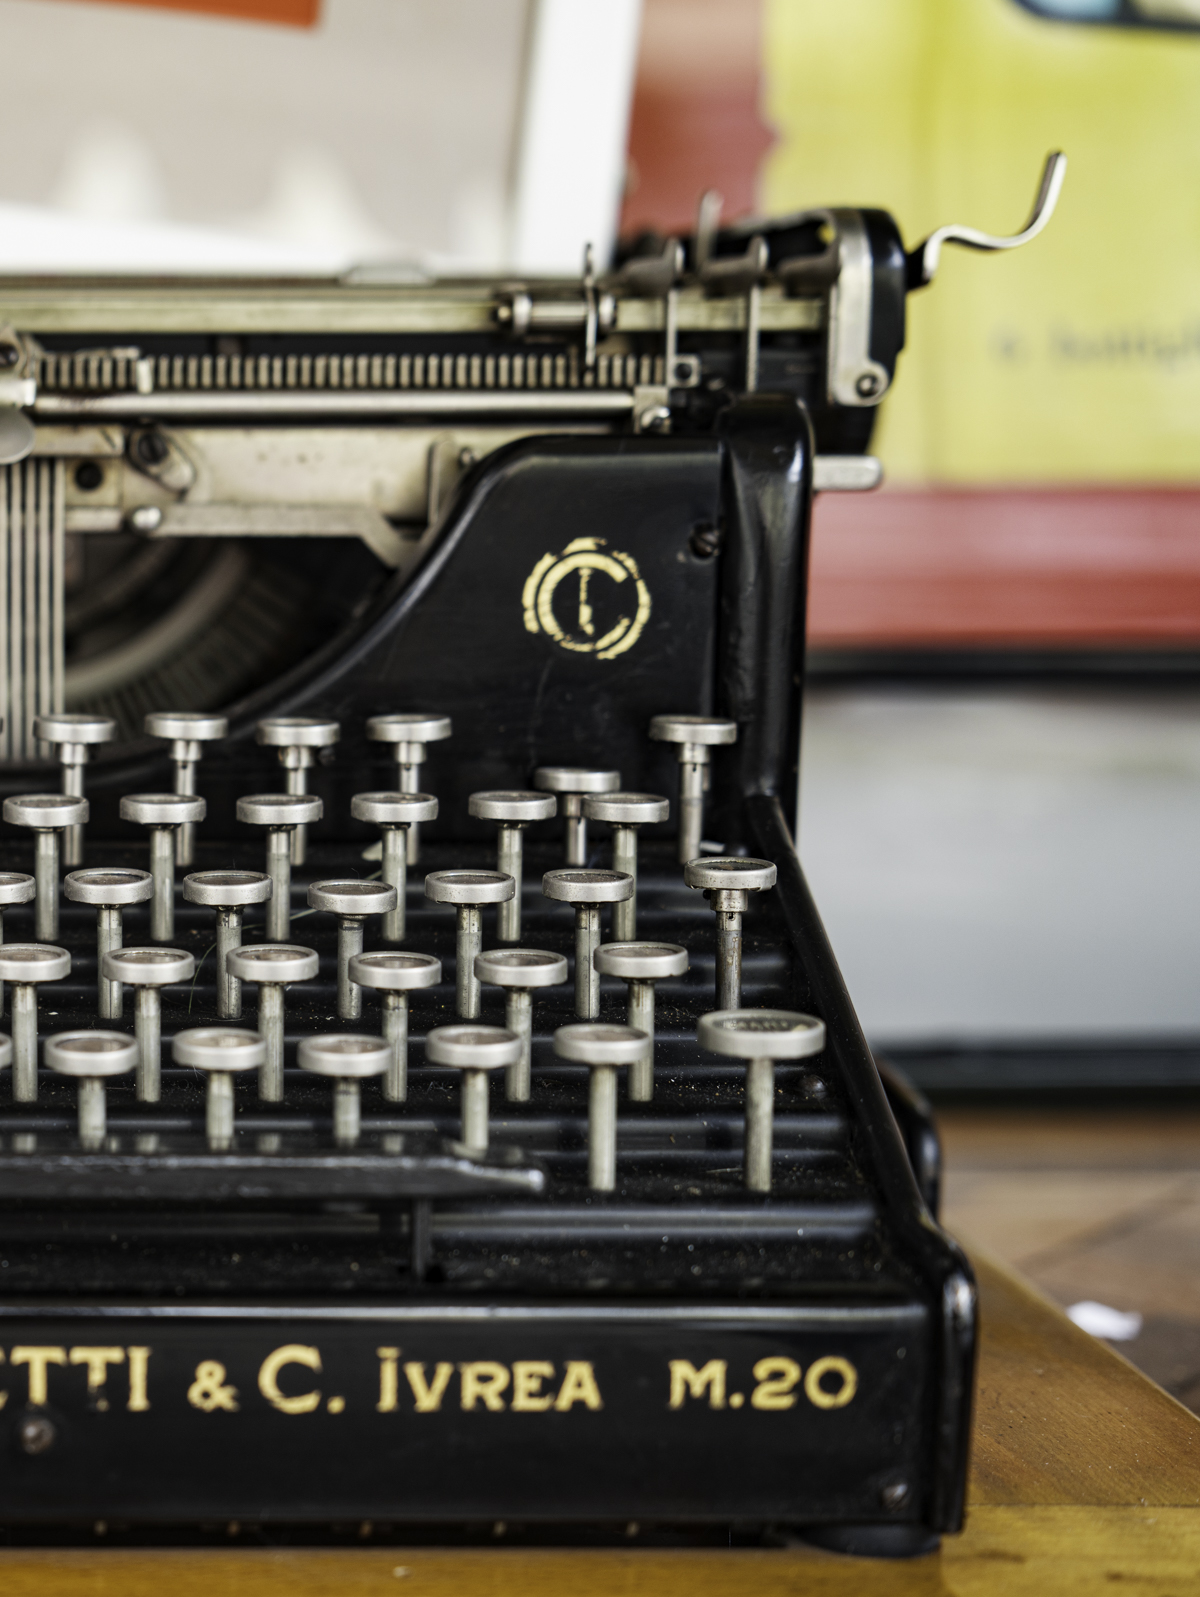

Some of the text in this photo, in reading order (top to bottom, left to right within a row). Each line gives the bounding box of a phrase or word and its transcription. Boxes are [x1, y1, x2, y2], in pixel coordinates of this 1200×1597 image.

[187, 1359, 236, 1412] &
[257, 1343, 346, 1414] C.
[668, 1355, 858, 1409] M.20
